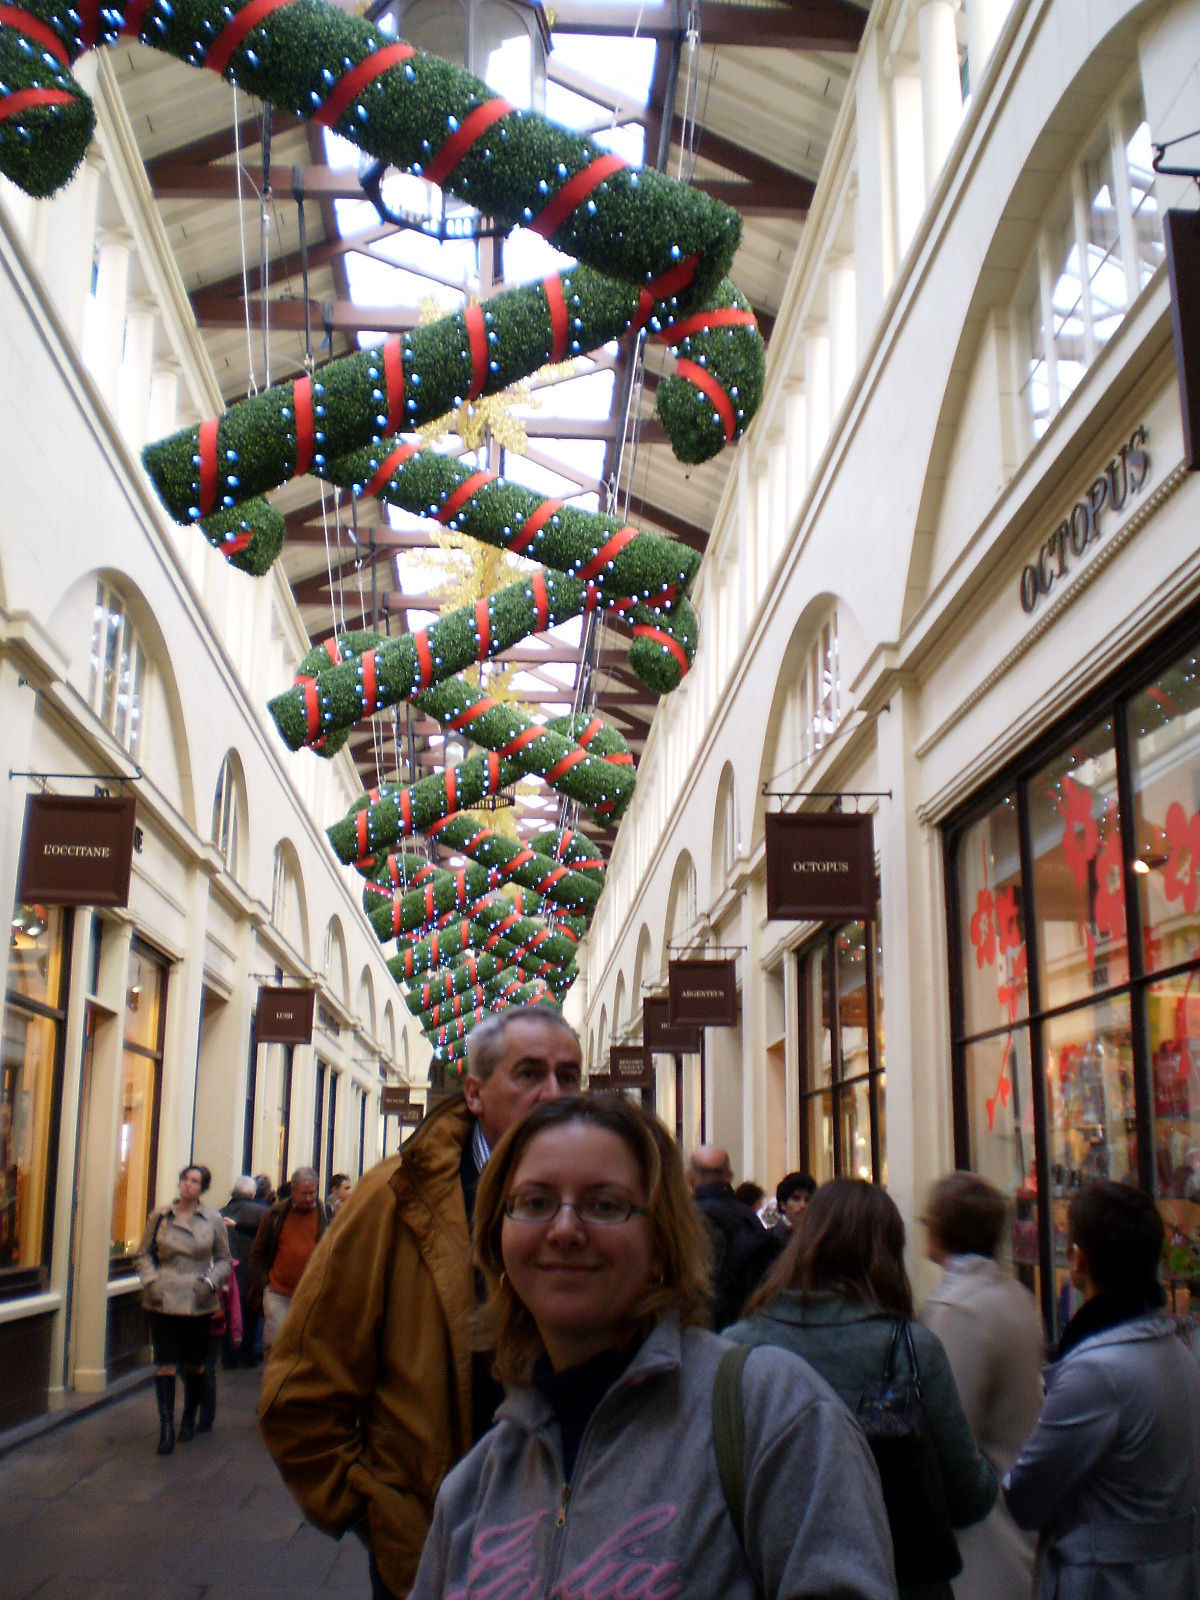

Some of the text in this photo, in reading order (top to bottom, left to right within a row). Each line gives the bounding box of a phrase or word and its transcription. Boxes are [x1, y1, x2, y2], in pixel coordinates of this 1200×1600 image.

[1020, 424, 1150, 613] OCTOPUS
[43, 844, 110, 858] L'OCCITANE
[792, 861, 849, 872] OCTOPUS
